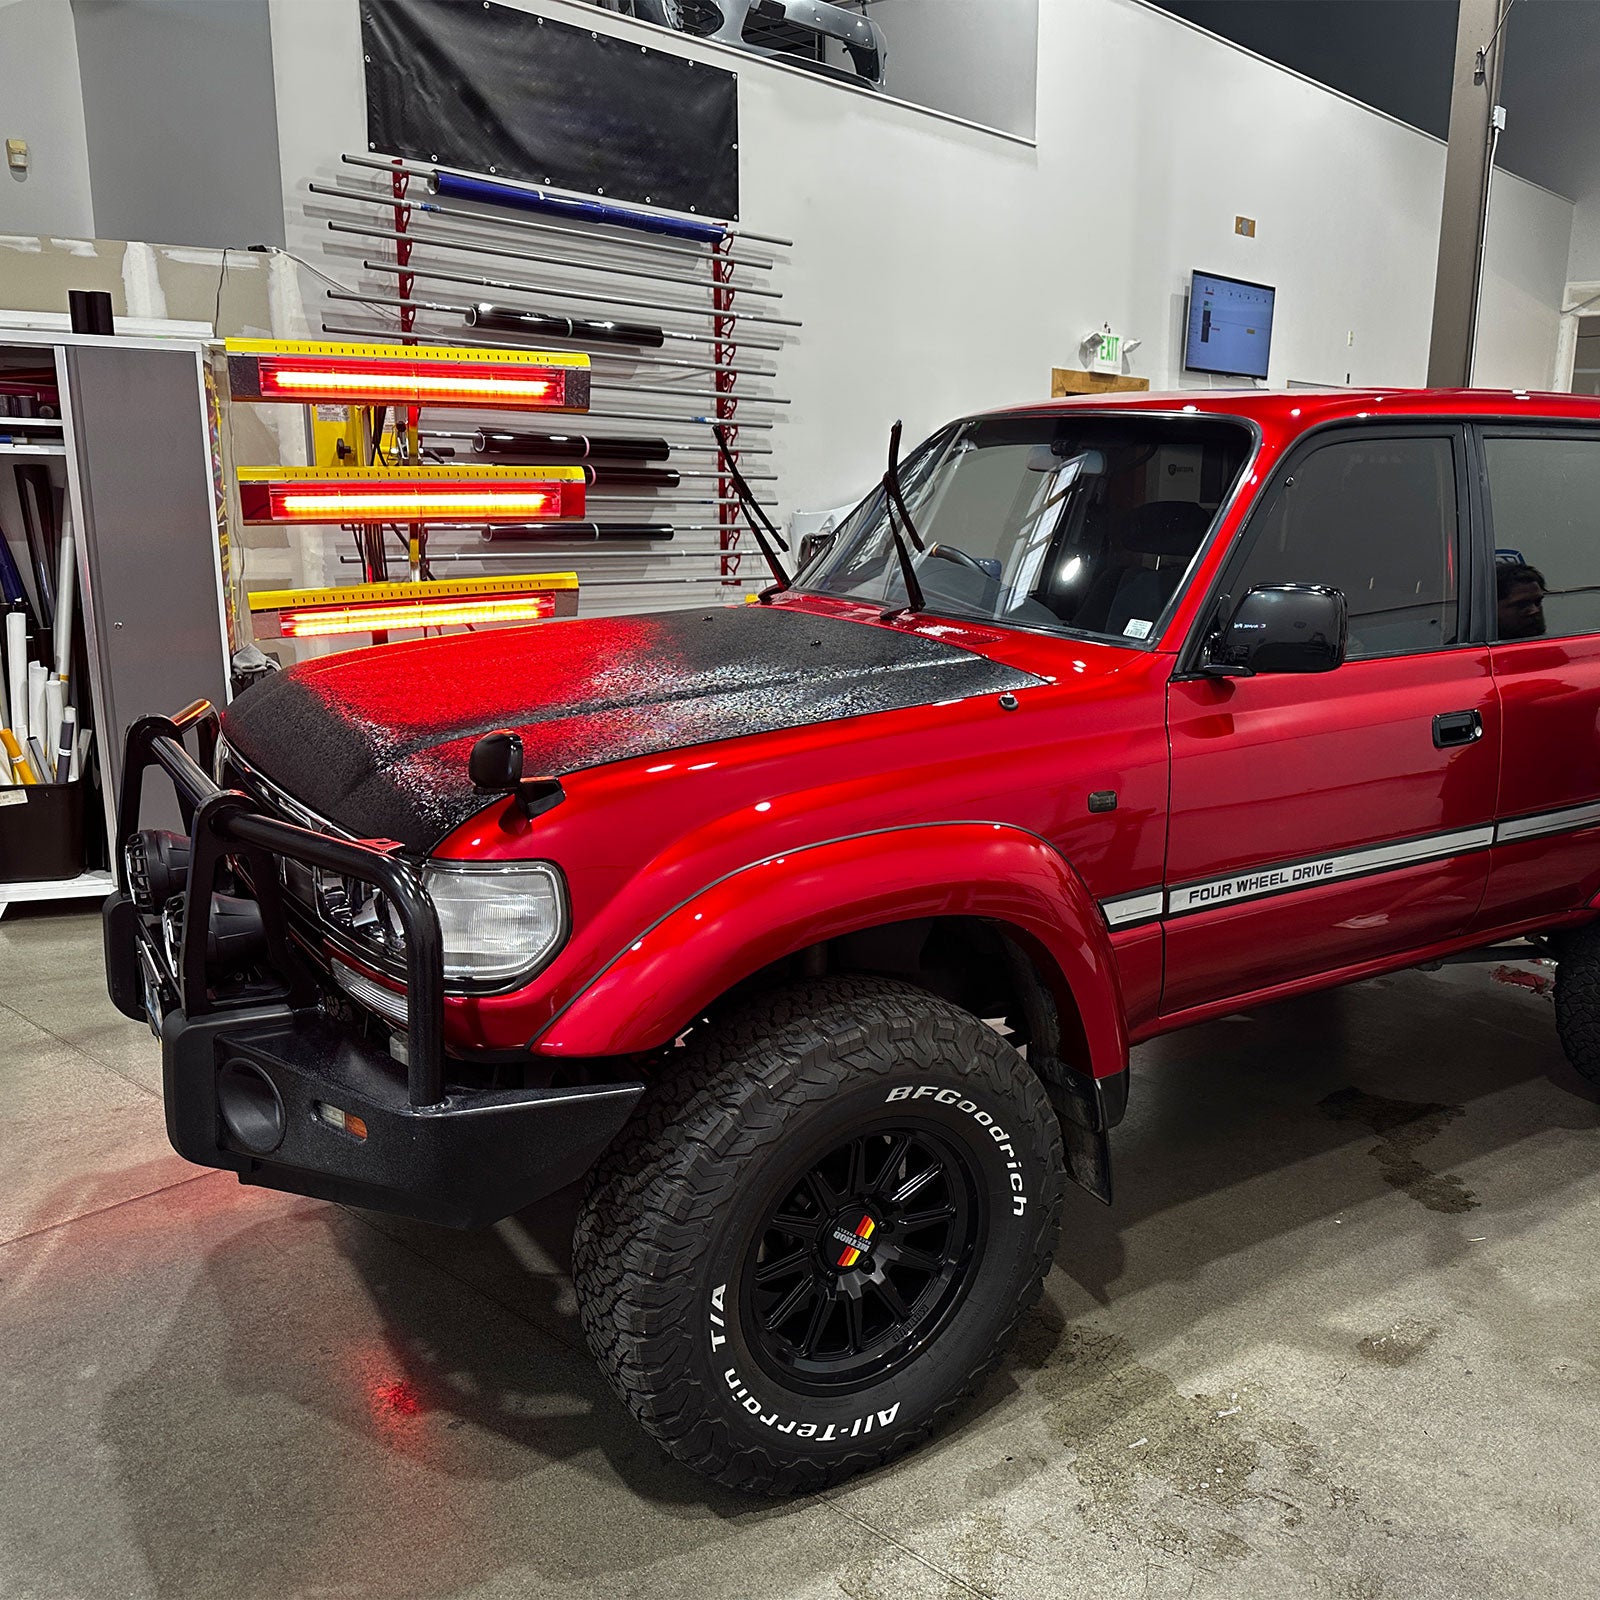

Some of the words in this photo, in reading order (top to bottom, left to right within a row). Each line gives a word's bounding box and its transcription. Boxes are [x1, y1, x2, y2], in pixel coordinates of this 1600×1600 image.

[1100, 335, 1120, 361] EXIT
[1189, 883, 1232, 903] FOUR
[1236, 872, 1289, 893] WHEEL
[1292, 862, 1334, 881] DRIVE
[885, 1086, 1027, 1216] BFGoodrich
[833, 1231, 870, 1253] METHOD
[710, 1284, 726, 1352] T/A
[724, 1368, 901, 1442] All-Terrain
